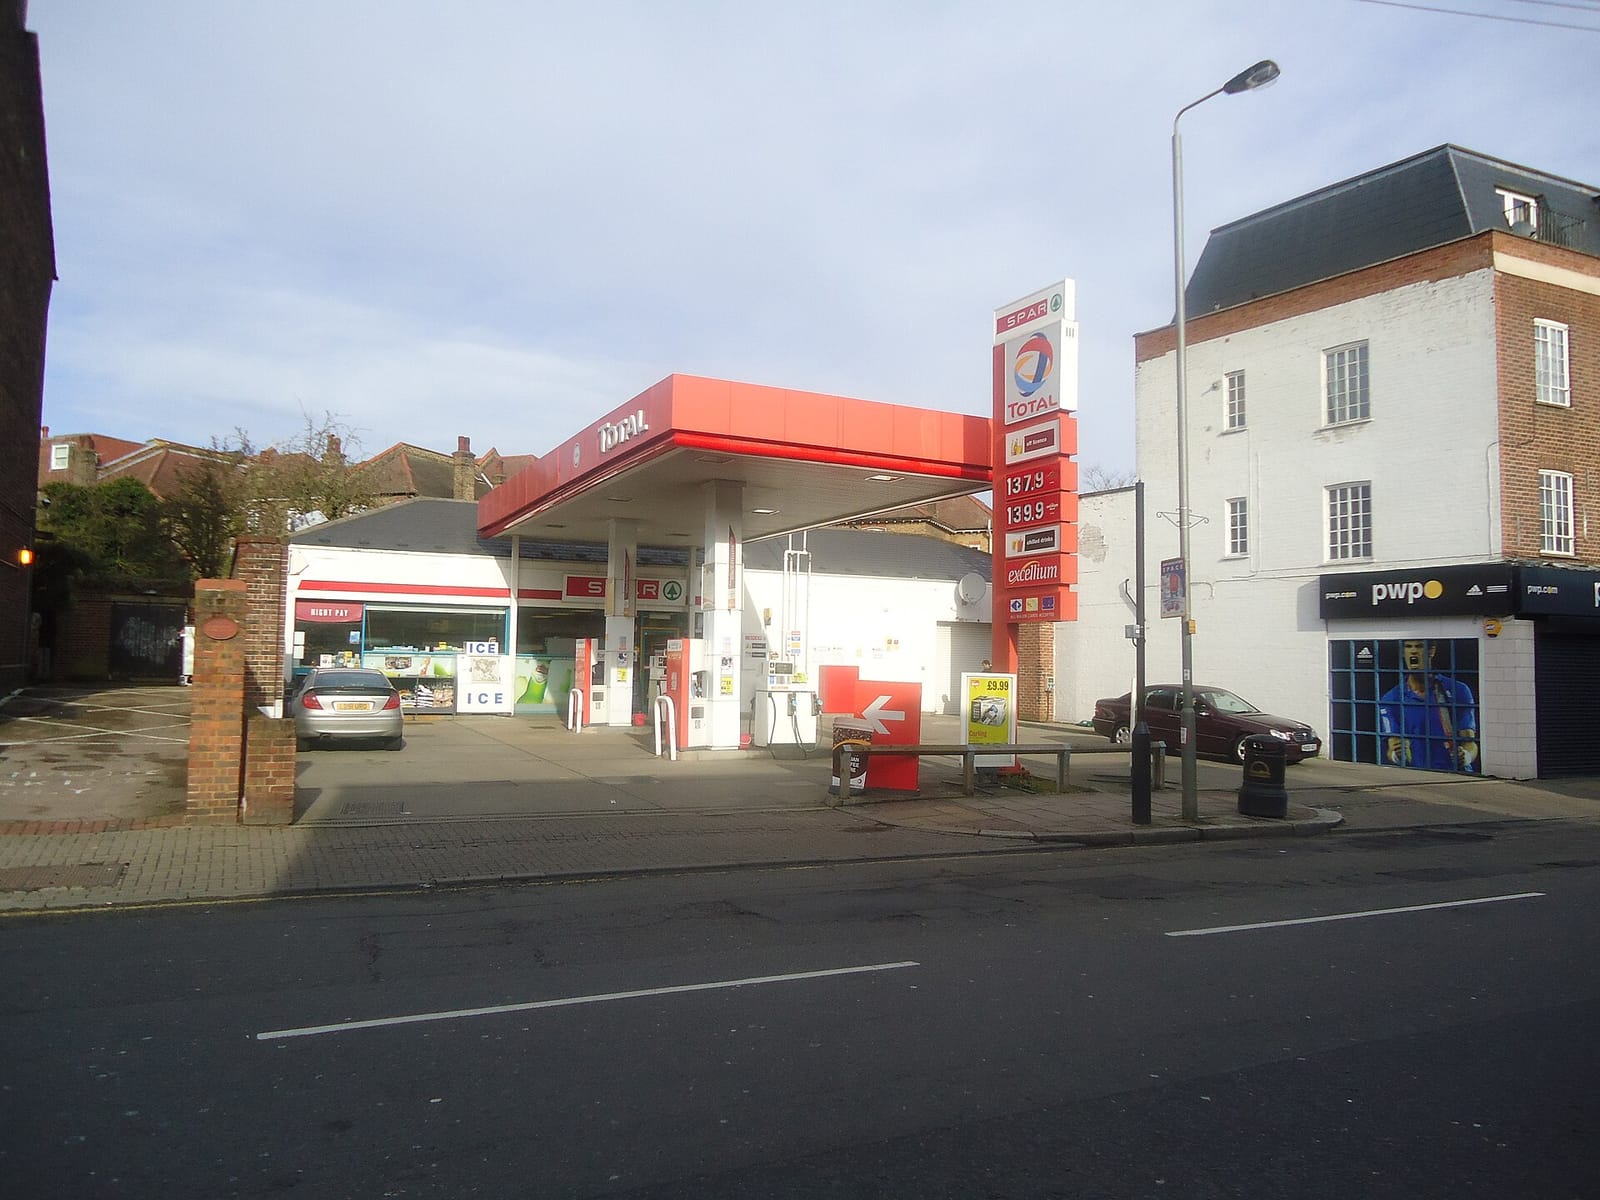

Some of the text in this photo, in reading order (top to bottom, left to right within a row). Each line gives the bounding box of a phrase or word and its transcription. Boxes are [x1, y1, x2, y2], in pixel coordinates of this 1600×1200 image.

[1007, 303, 1047, 327] SPAR
[1008, 394, 1058, 418] TOTAL
[598, 410, 648, 452] TOTAL
[1007, 471, 1044, 496] 137.9
[1007, 501, 1044, 525] 139.9
[1008, 563, 1058, 585] excellium
[588, 581, 657, 597] SR
[1527, 585, 1558, 595] pwp.com
[335, 609, 348, 617] PAY
[469, 643, 496, 654] ICE
[987, 681, 1008, 690] £9.99
[467, 693, 503, 705] ICE
